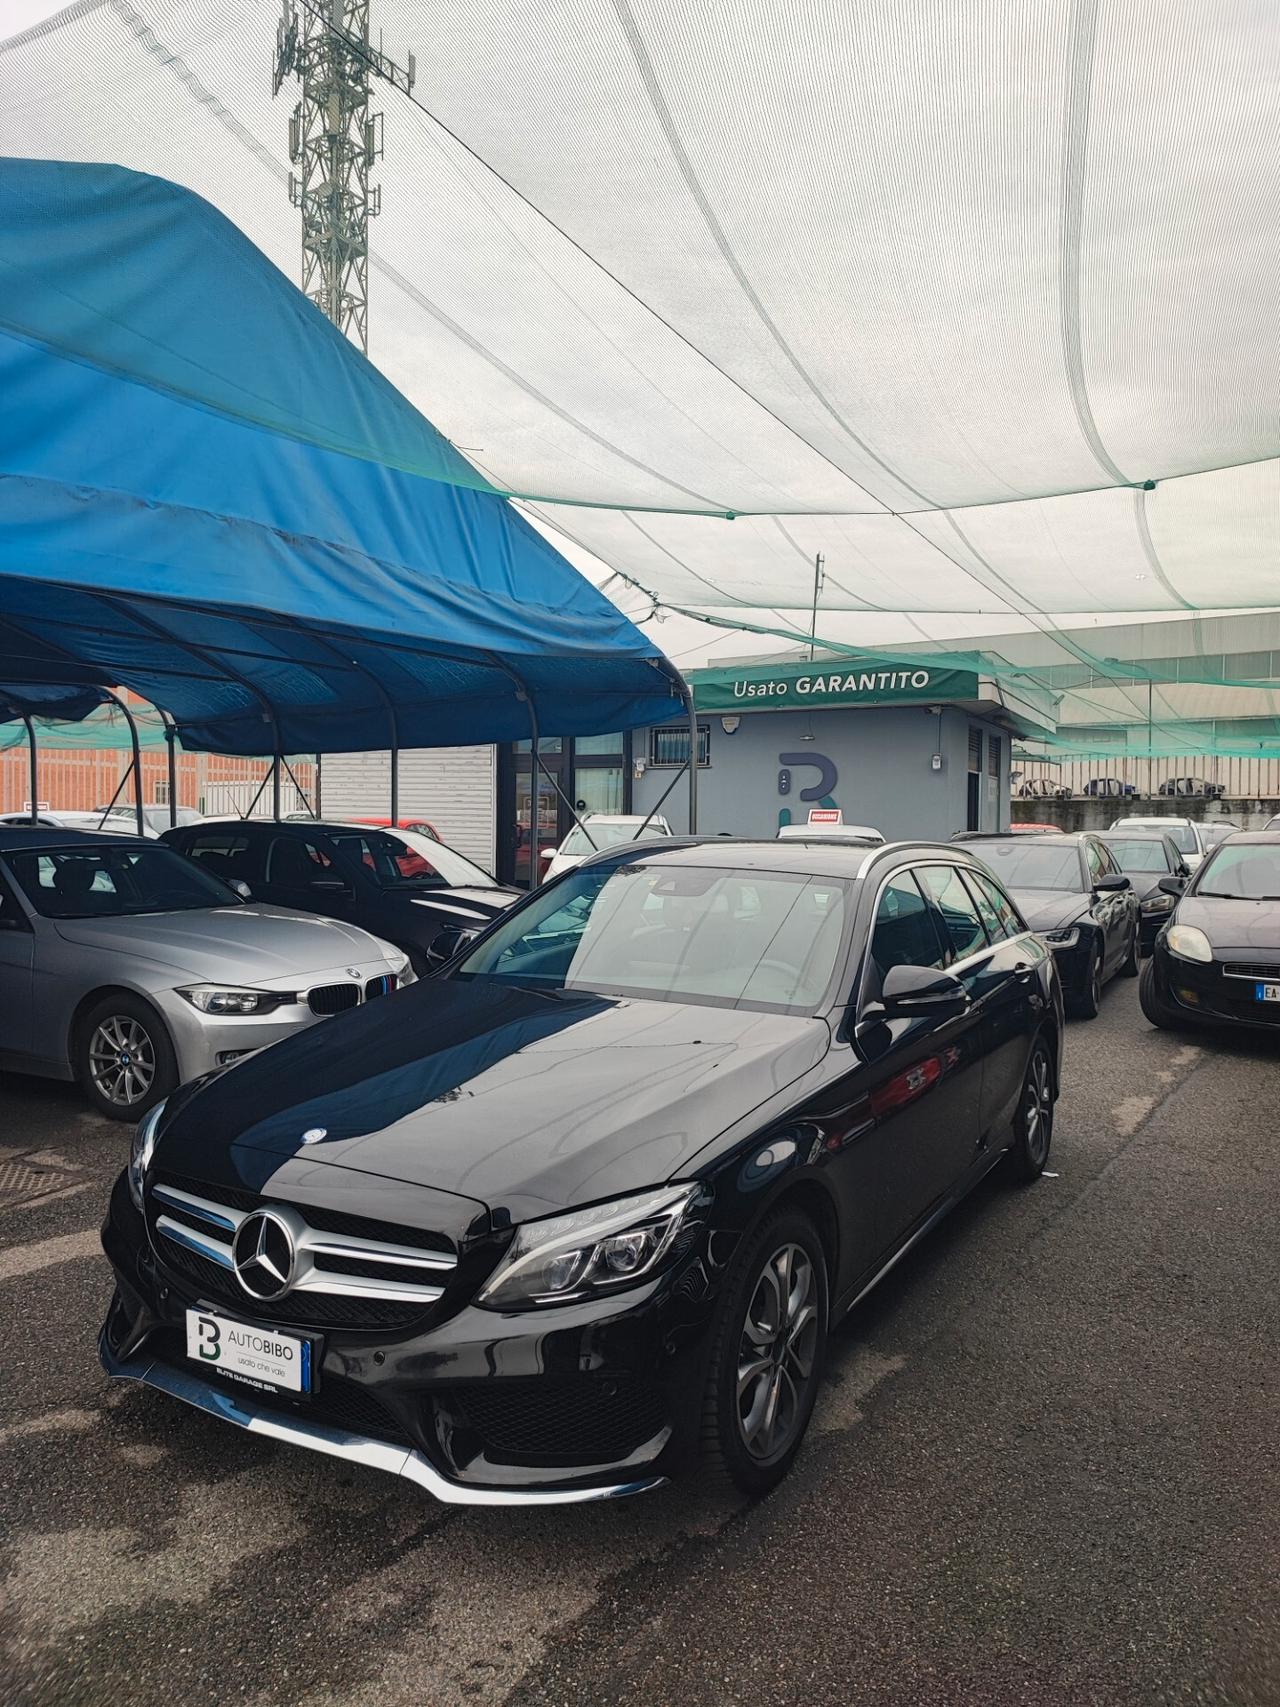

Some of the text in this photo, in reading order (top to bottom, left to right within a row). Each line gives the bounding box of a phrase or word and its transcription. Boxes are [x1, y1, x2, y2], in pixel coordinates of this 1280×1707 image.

[734, 670, 930, 698] Usato GARANTITO
[228, 1330, 293, 1361] AUTOBIBO
[238, 1357, 286, 1378] usato che vale
